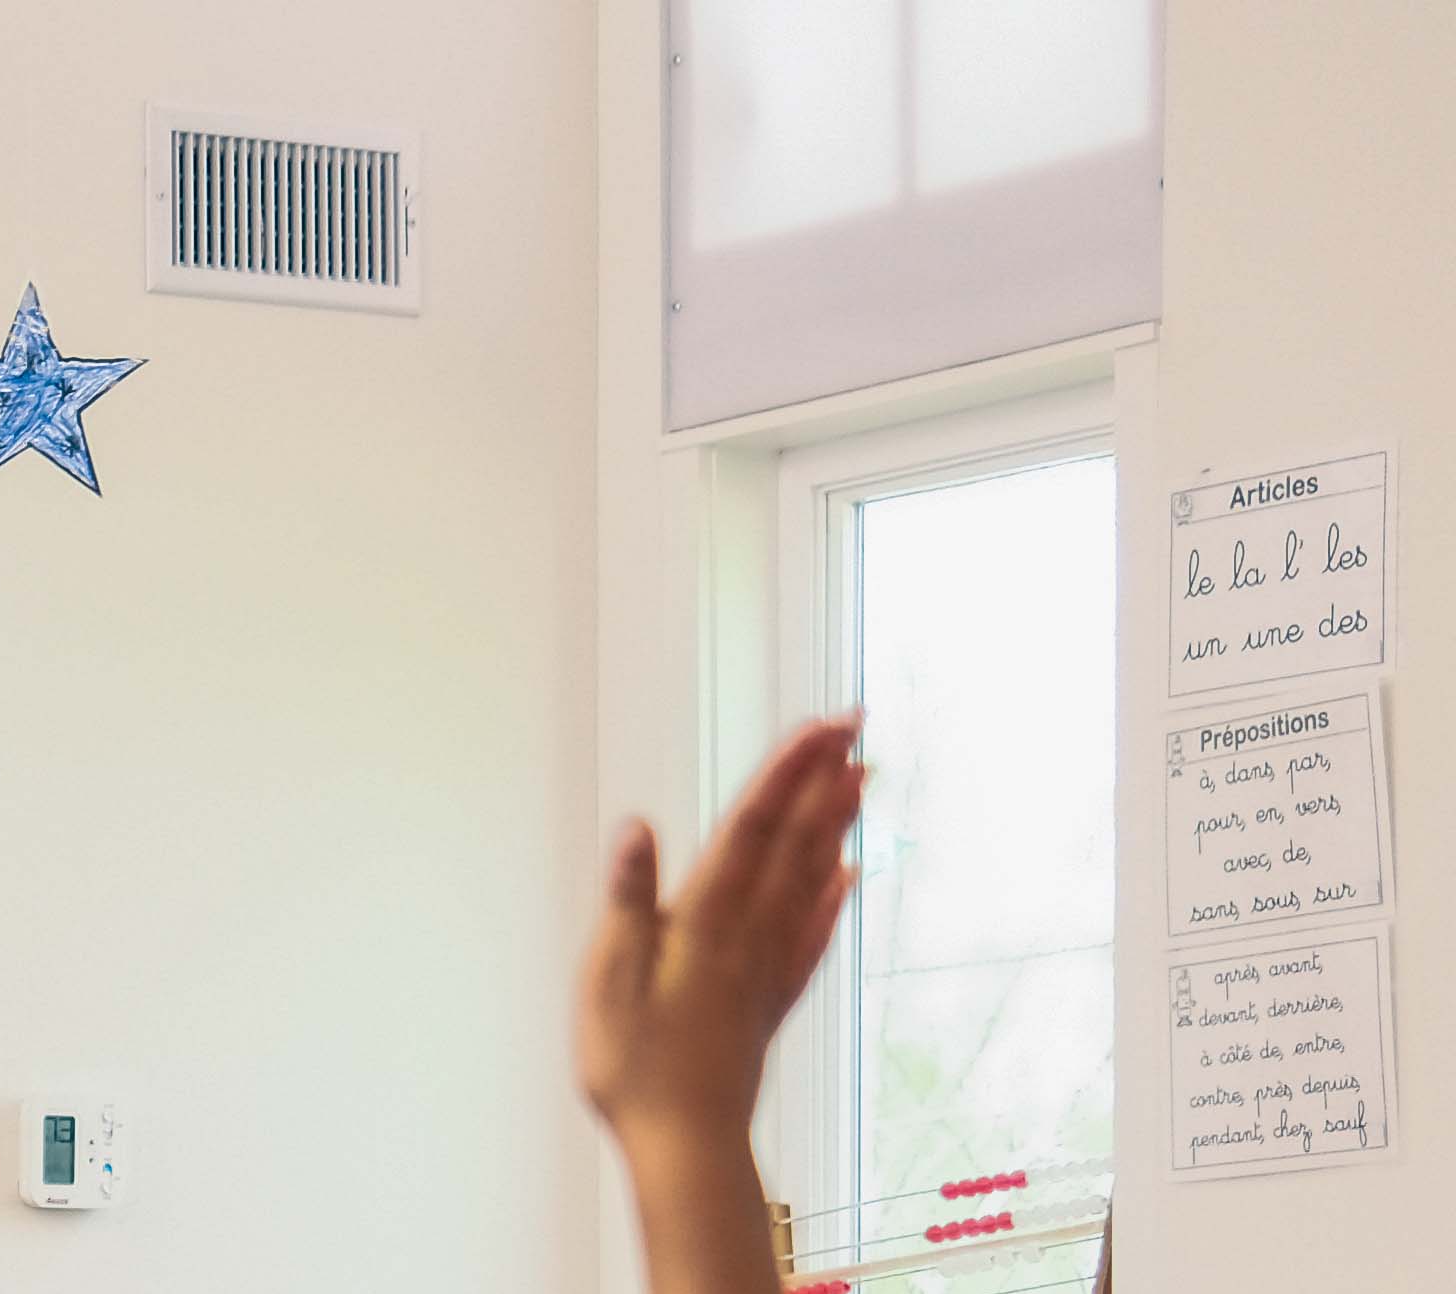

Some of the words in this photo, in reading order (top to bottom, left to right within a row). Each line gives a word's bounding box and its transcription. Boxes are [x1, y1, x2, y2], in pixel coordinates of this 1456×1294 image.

[1230, 476, 1318, 509] Articles
[1184, 549, 1215, 599] le
[1230, 541, 1266, 590] la
[1281, 530, 1303, 581] l'
[1324, 523, 1367, 573] les
[1183, 638, 1227, 662] un
[1242, 624, 1304, 651] une
[1318, 604, 1368, 637] des
[1199, 712, 1329, 755] Prépositions
